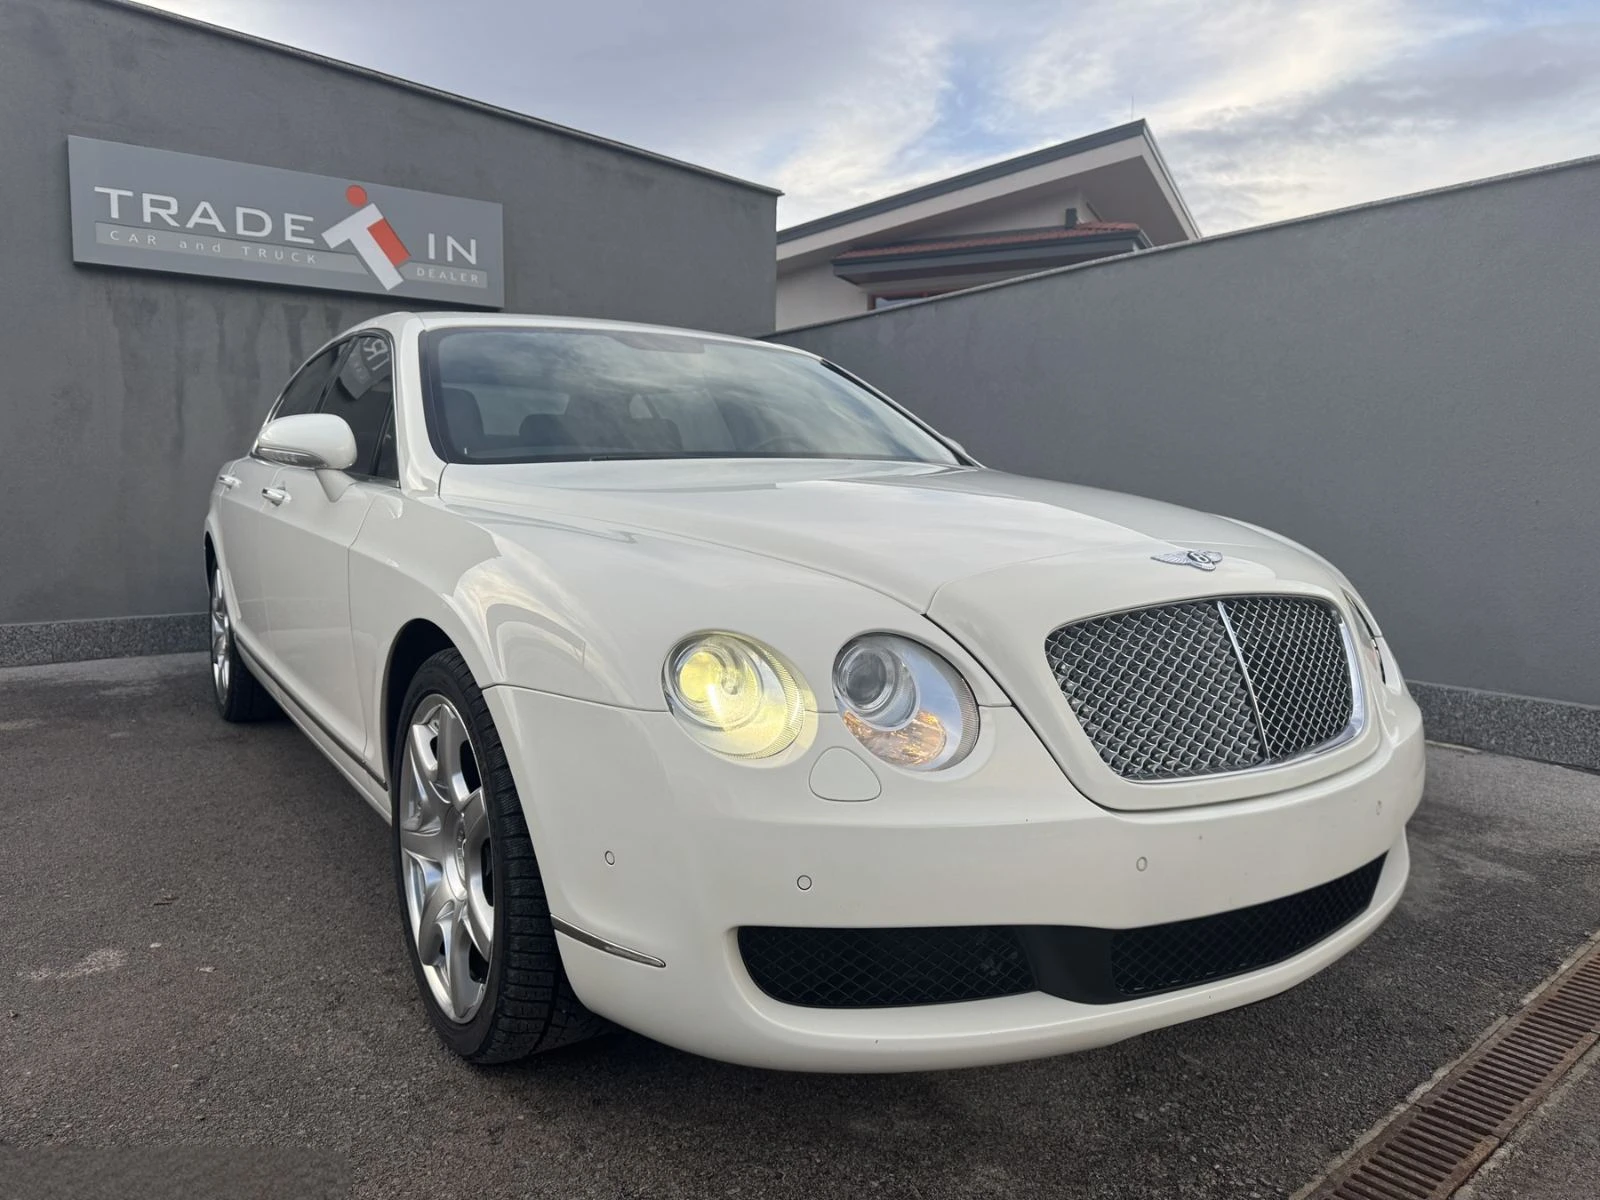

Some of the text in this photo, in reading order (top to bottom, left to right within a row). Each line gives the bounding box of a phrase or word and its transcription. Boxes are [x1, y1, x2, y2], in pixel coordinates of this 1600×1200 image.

[94, 186, 315, 244] TRADE
[428, 233, 477, 265] IN
[110, 230, 479, 283] CAR and TRUCK DEALER
